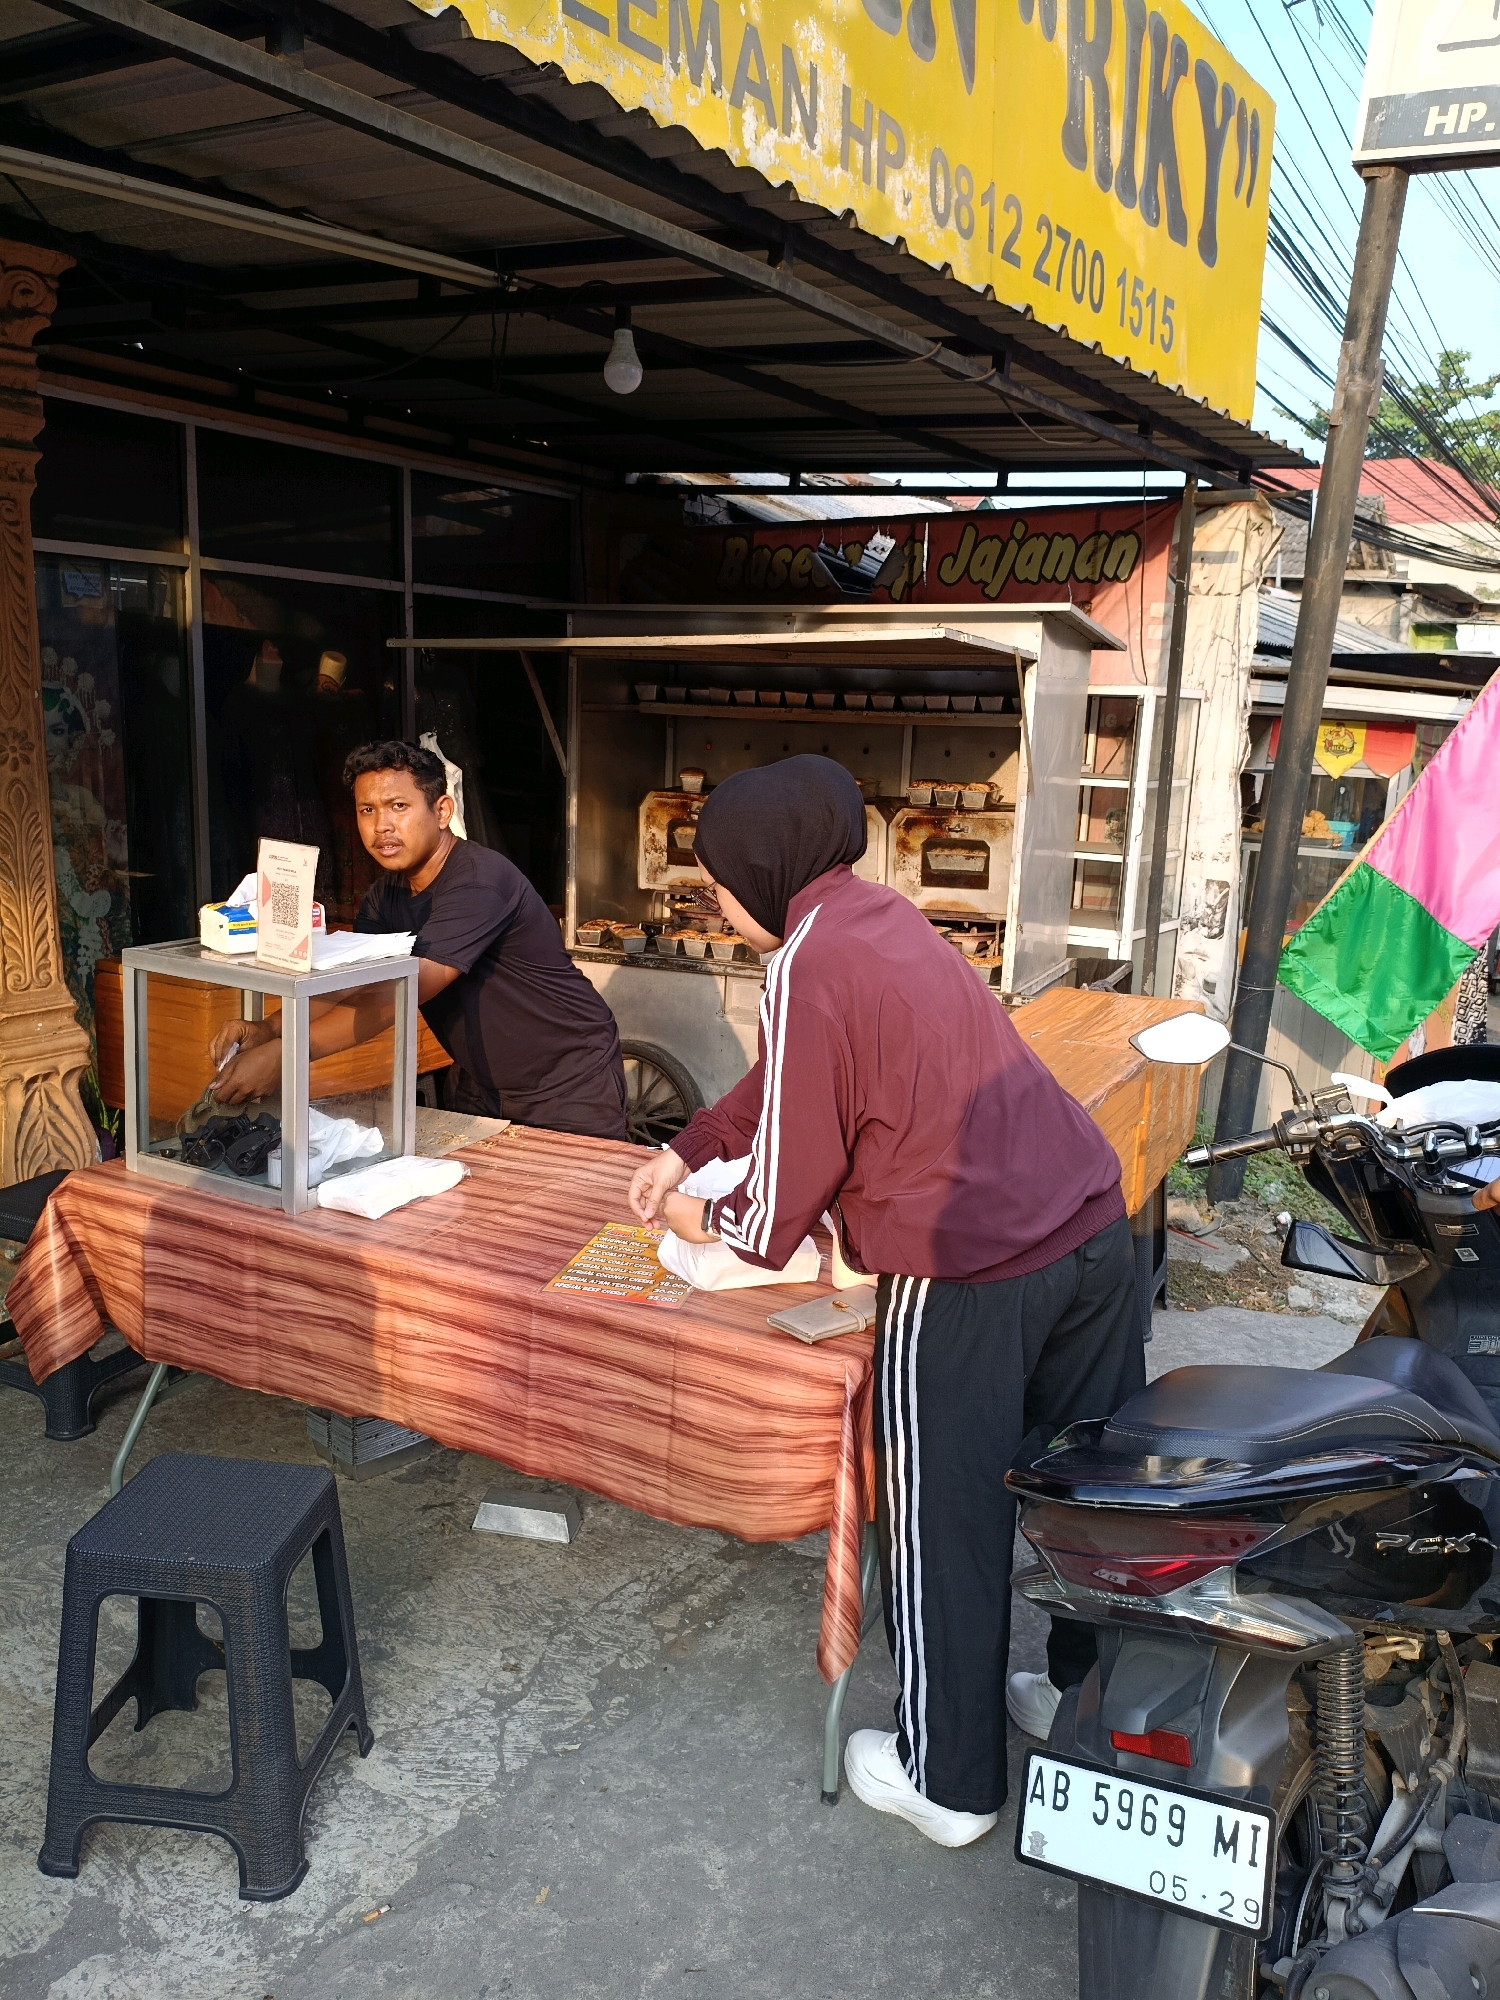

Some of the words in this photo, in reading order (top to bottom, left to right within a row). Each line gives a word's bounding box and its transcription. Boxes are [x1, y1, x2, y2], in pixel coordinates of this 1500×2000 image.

[1423, 102, 1496, 137] HP.
[929, 146, 1022, 269] 0812
[1033, 213, 1105, 315] 2700
[1116, 267, 1176, 354] 1515
[938, 518, 1142, 600] Jajanan
[1029, 1765, 1070, 1812] AB
[1092, 1781, 1186, 1847] 5969
[1213, 1814, 1261, 1867] MI
